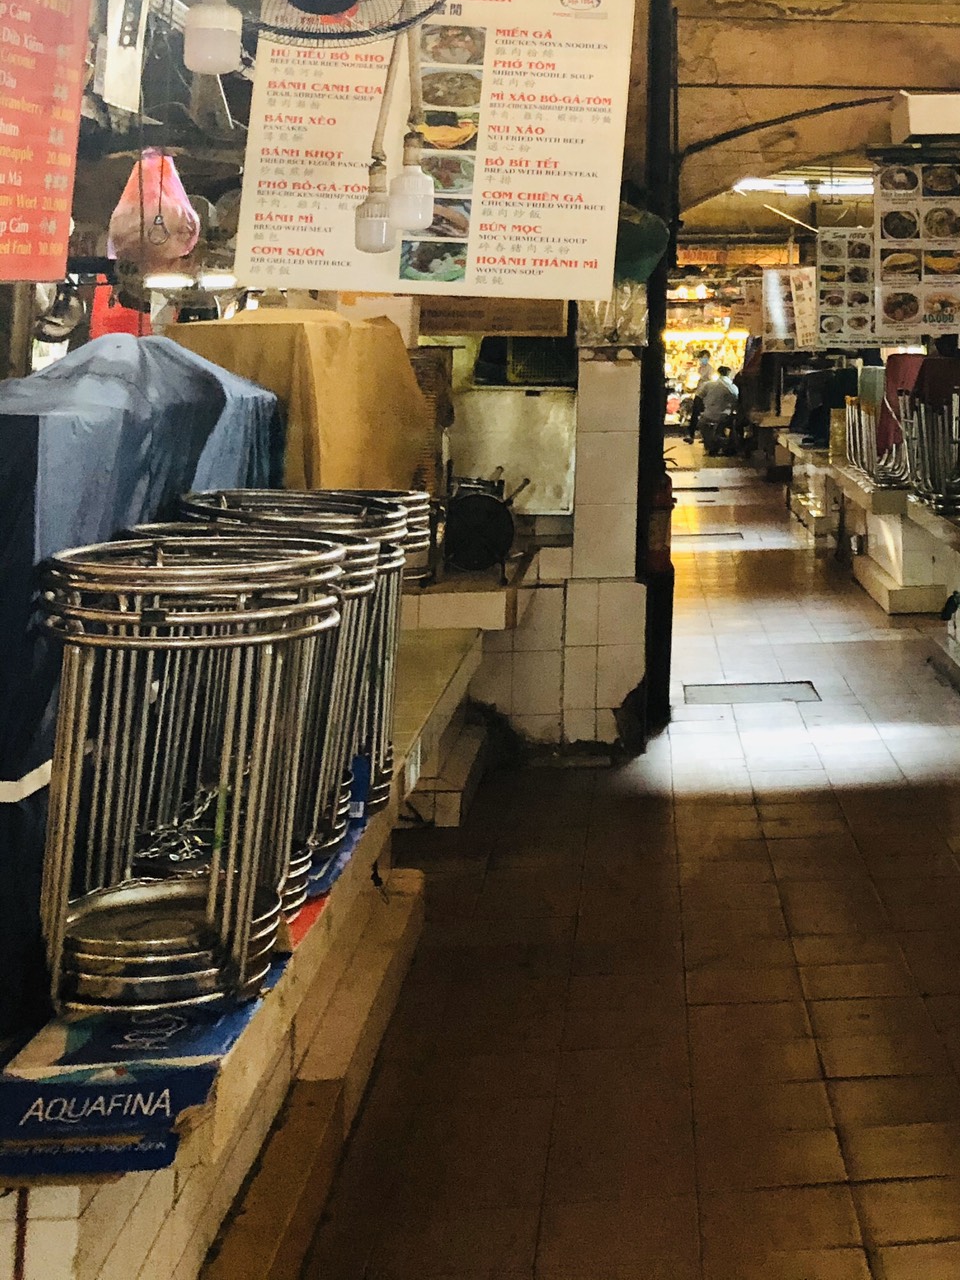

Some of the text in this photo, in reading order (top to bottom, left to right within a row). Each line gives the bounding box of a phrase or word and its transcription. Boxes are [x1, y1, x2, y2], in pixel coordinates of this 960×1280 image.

[566, 42, 608, 50] NOODLES
[355, 52, 384, 63] KHO
[528, 60, 556, 70] TÔM
[268, 80, 383, 94] BÁNH CANH CUA
[491, 91, 504, 100] MÌ
[264, 113, 337, 126] BÁNH XÈO
[488, 124, 545, 135] NUI XÀO
[261, 146, 343, 160] BÁNH KHỌT
[485, 156, 504, 166] BÒ
[545, 170, 598, 178] BEEFSTEAK
[482, 190, 512, 199] CƠM
[564, 193, 584, 203] GÀ
[255, 211, 314, 223] BÁNH MÌ
[480, 221, 542, 235] BÚN MỌC
[503, 235, 561, 243] VERMICELLI
[251, 246, 282, 255] CƠM
[531, 257, 578, 268] THÁNH
[583, 258, 598, 269] MÌ
[18, 1088, 171, 1126] AQUAFINA
